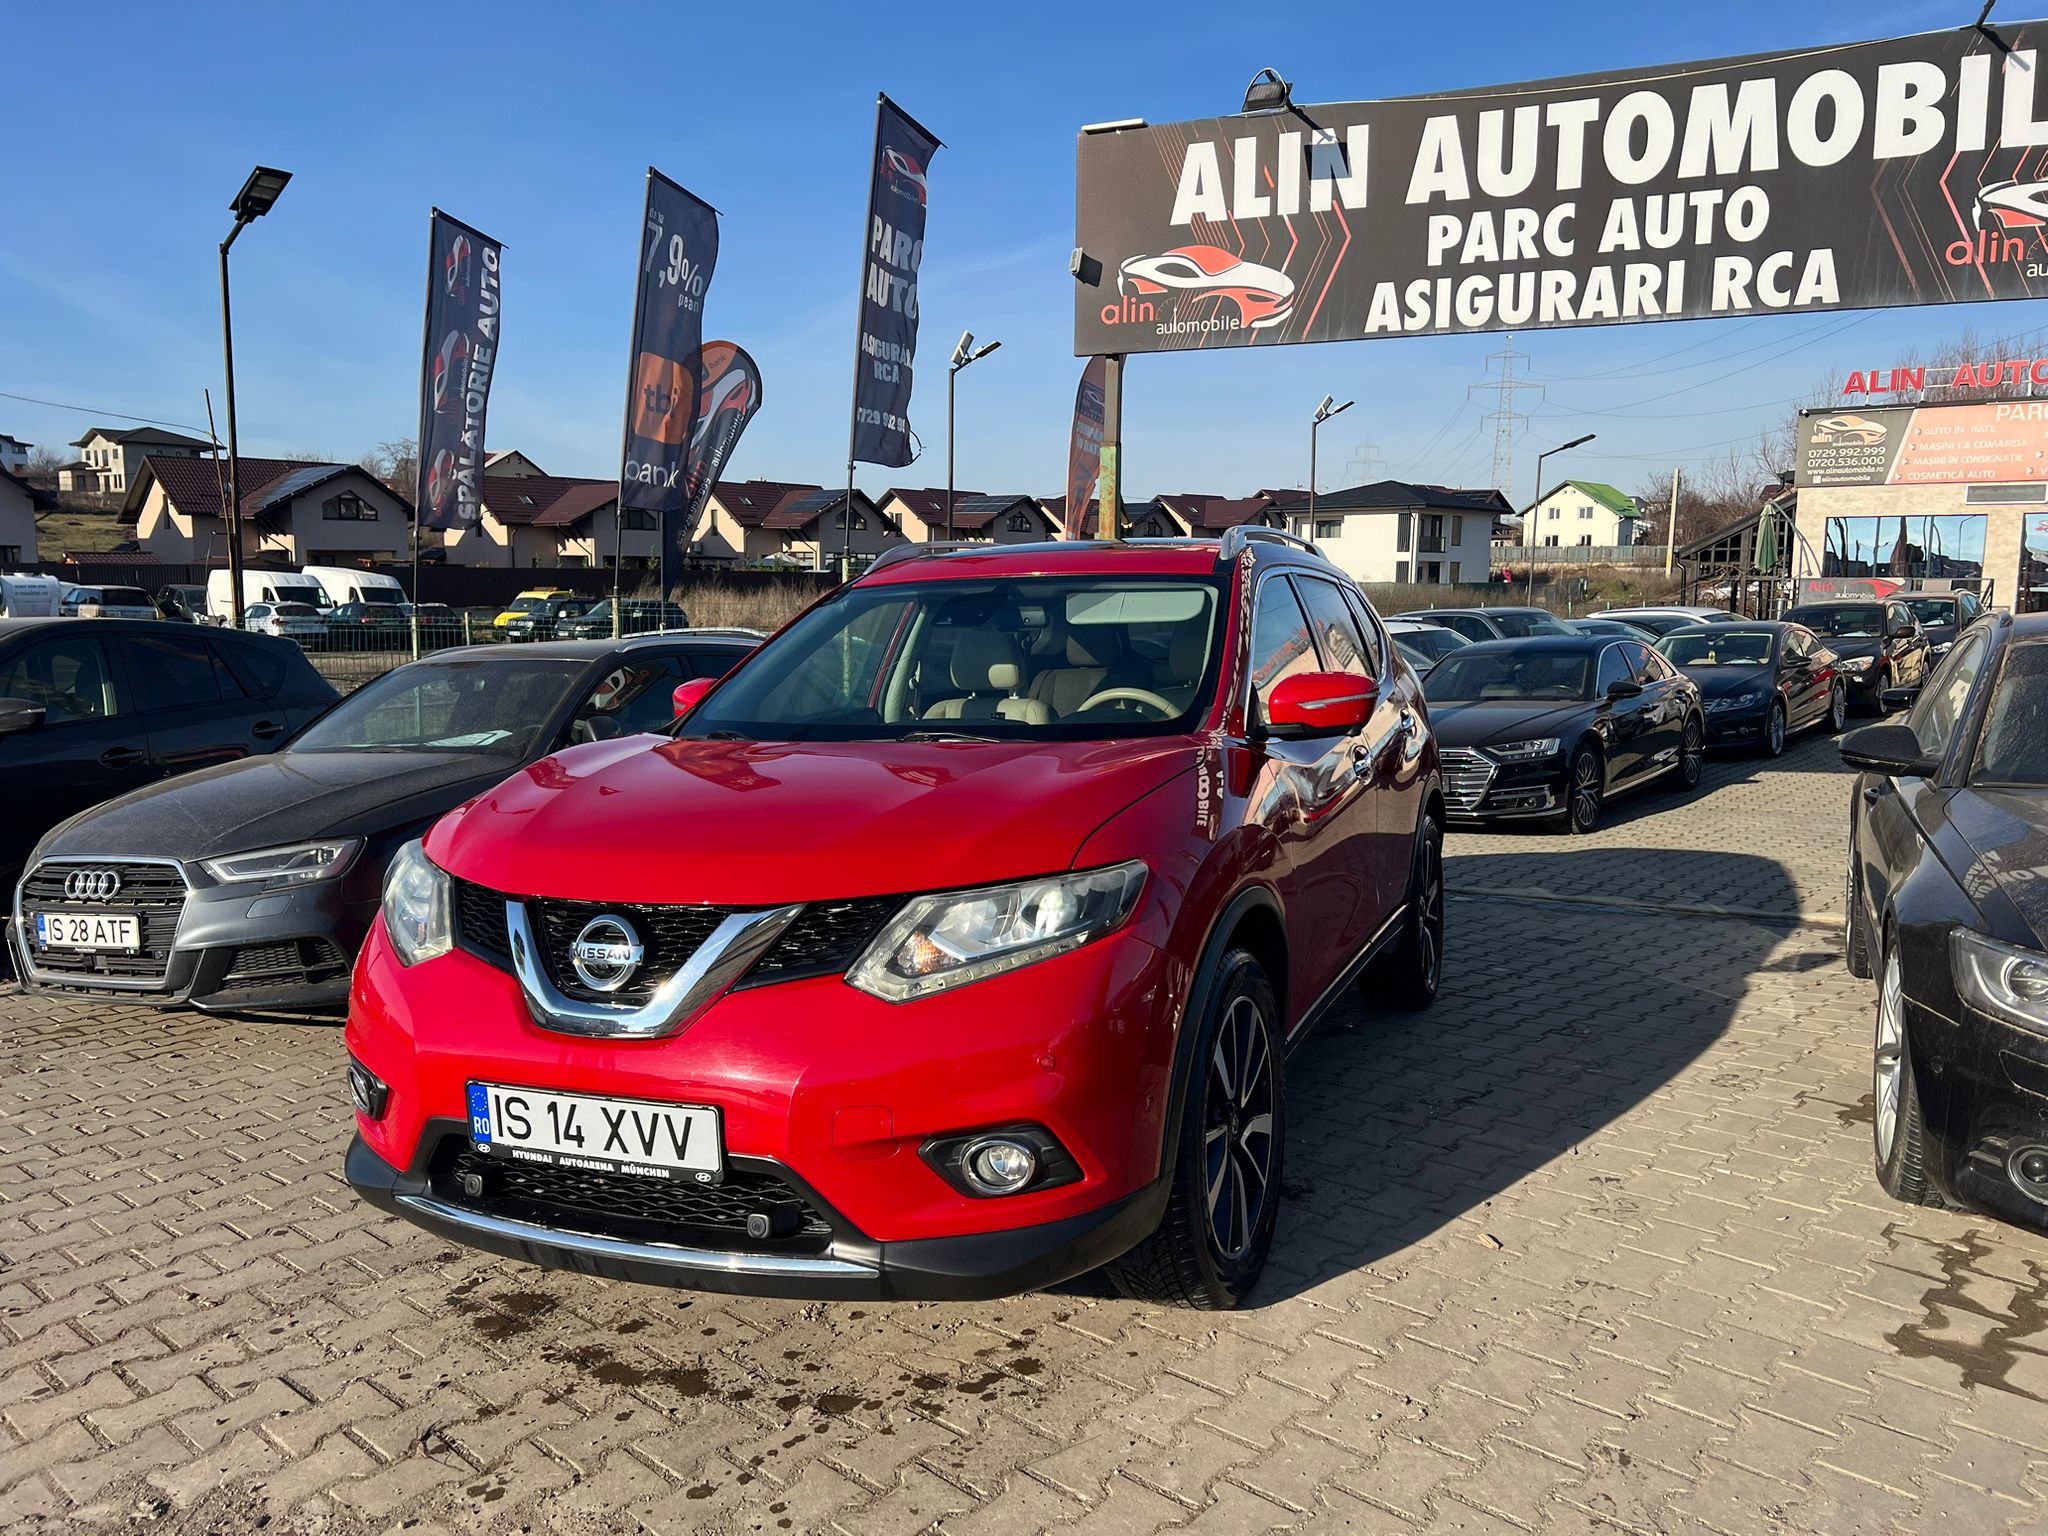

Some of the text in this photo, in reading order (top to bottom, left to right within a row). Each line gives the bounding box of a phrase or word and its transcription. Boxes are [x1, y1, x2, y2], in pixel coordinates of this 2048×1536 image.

[1170, 49, 2048, 225] ALIN AUTOMOBIL
[1427, 185, 1770, 267] PARC AUTO
[645, 220, 703, 297] 7,9%
[1945, 228, 2025, 266] alin
[867, 262, 918, 320] AUTO
[1364, 247, 1841, 334] ASIGURARI RCA
[1101, 295, 1155, 326] alin
[1156, 310, 1241, 335] automobile
[453, 247, 498, 521] SPĂLĂTORIE AUTO
[873, 360, 900, 384] RCA
[1843, 367, 1925, 394] ALIN
[1995, 404, 2048, 422] PAR
[712, 412, 745, 468] automobile
[1924, 426, 1951, 435] AUTO
[1970, 424, 1997, 434] RATE
[1808, 447, 1886, 458] 0729.992.999
[1957, 440, 1971, 449] LA
[625, 452, 680, 489] bank
[1807, 456, 1885, 467] 0720.536.000
[1807, 466, 1884, 475] www.alinautomobile.ro
[1822, 475, 1871, 483] alinautomobile
[1967, 470, 1996, 479] AUTO
[1808, 580, 1834, 592] Alin
[1834, 589, 1875, 599] automobile
[48, 918, 131, 943] IS 28 ATF
[574, 948, 631, 961] NISSAN
[473, 1116, 490, 1135] RO
[494, 1094, 692, 1161] IS 14 XVV
[512, 1149, 670, 1178] HYUNDAI AUTOARENA MÜNCHEN
